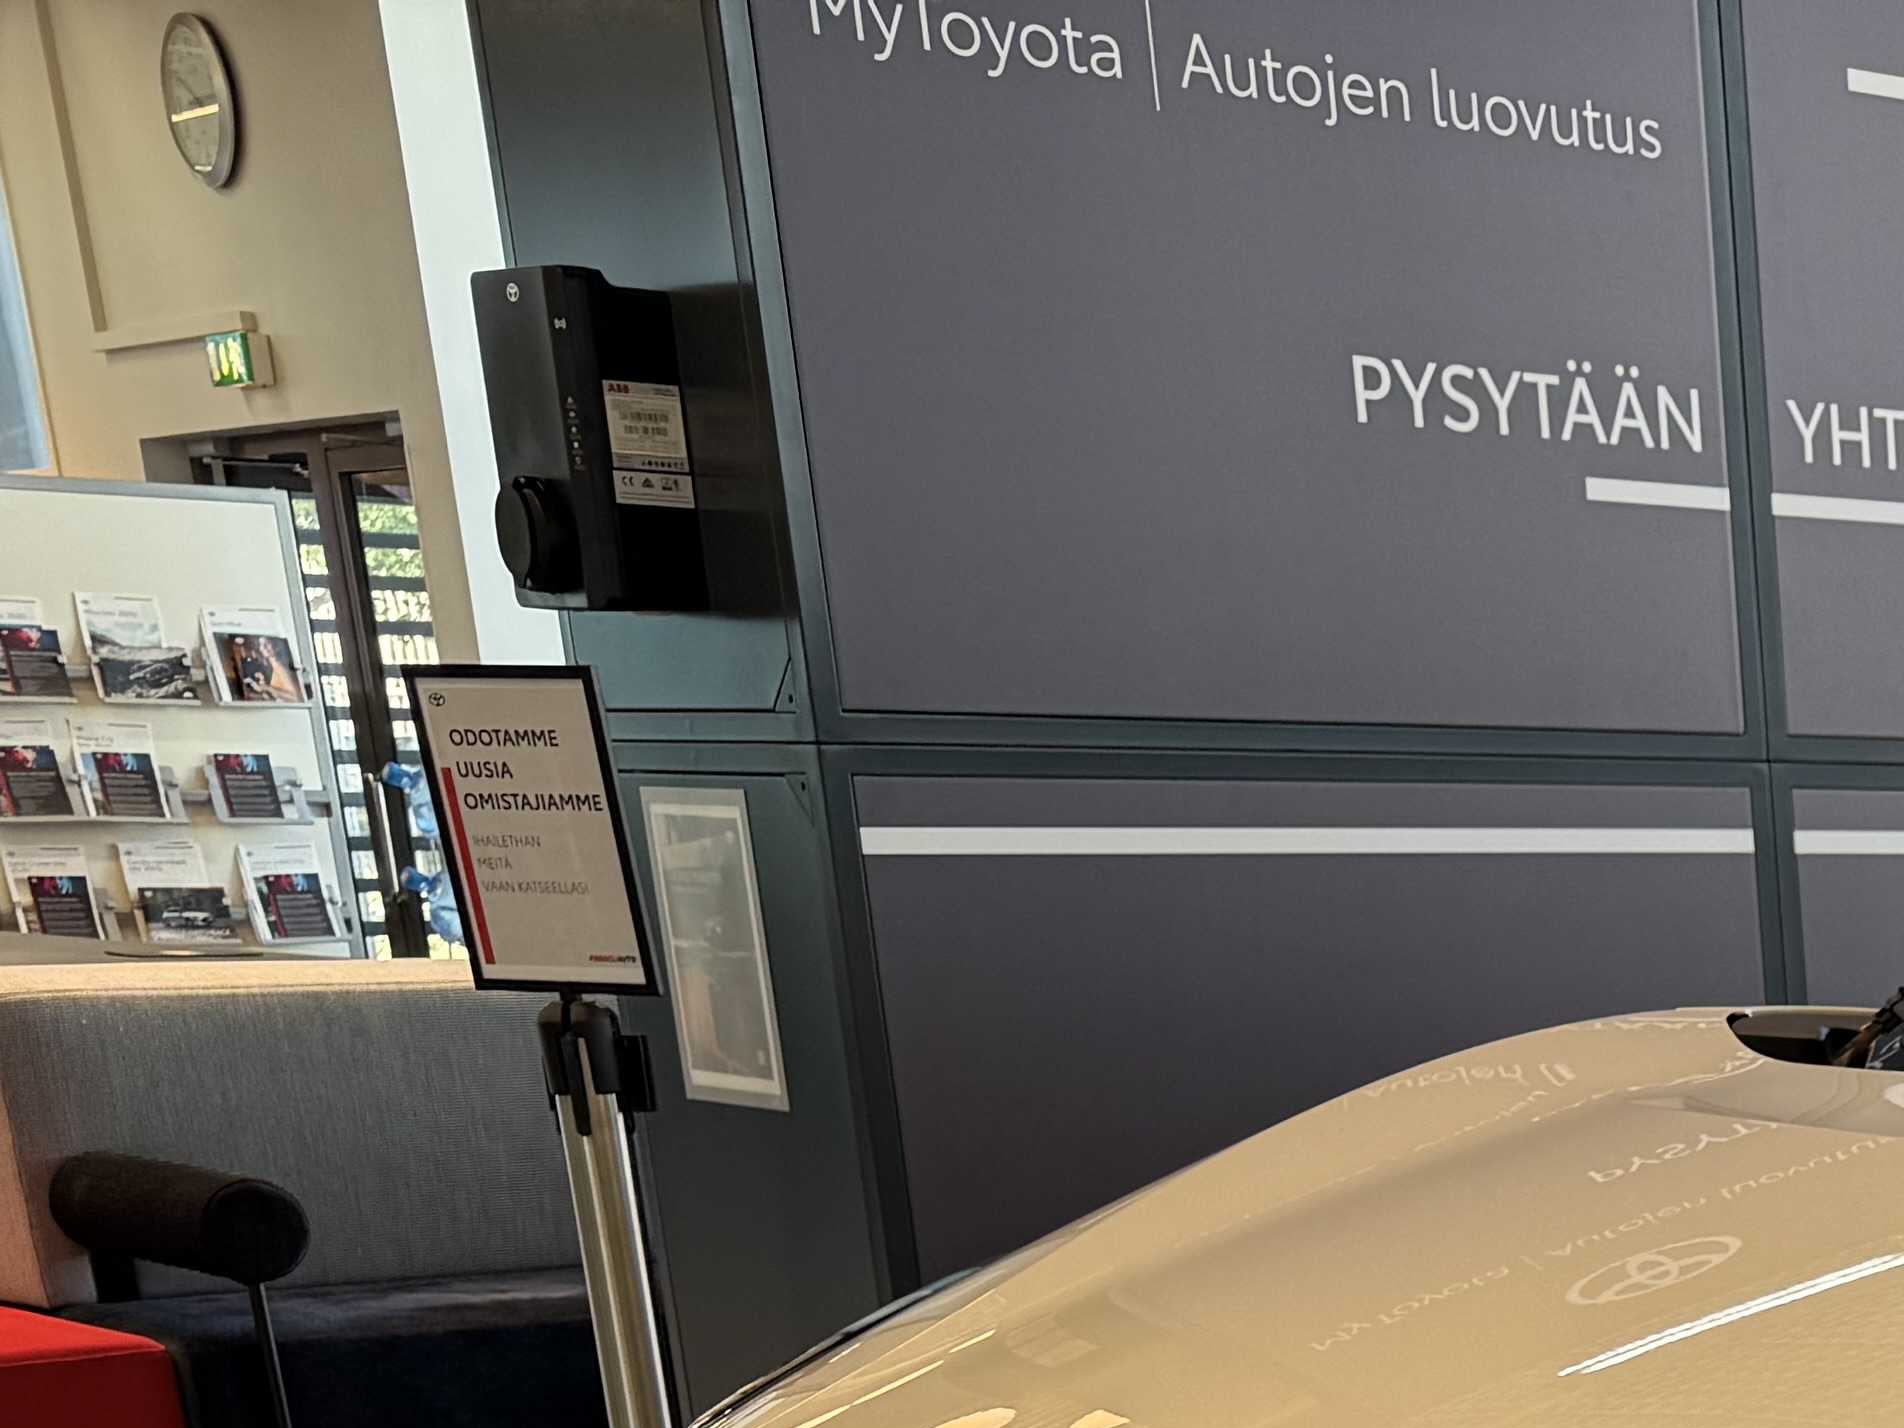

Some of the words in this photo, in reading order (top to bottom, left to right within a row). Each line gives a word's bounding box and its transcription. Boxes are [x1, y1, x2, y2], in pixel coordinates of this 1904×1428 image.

[1181, 33, 1412, 127] Autojen
[1430, 67, 1663, 159] luovutus
[607, 383, 630, 394] ABB
[1351, 354, 1703, 453] PYSYTÄÄN
[448, 728, 560, 748] ODOTAMME
[455, 760, 514, 780] UUSIA
[463, 792, 604, 812] OMISTAJIAMME
